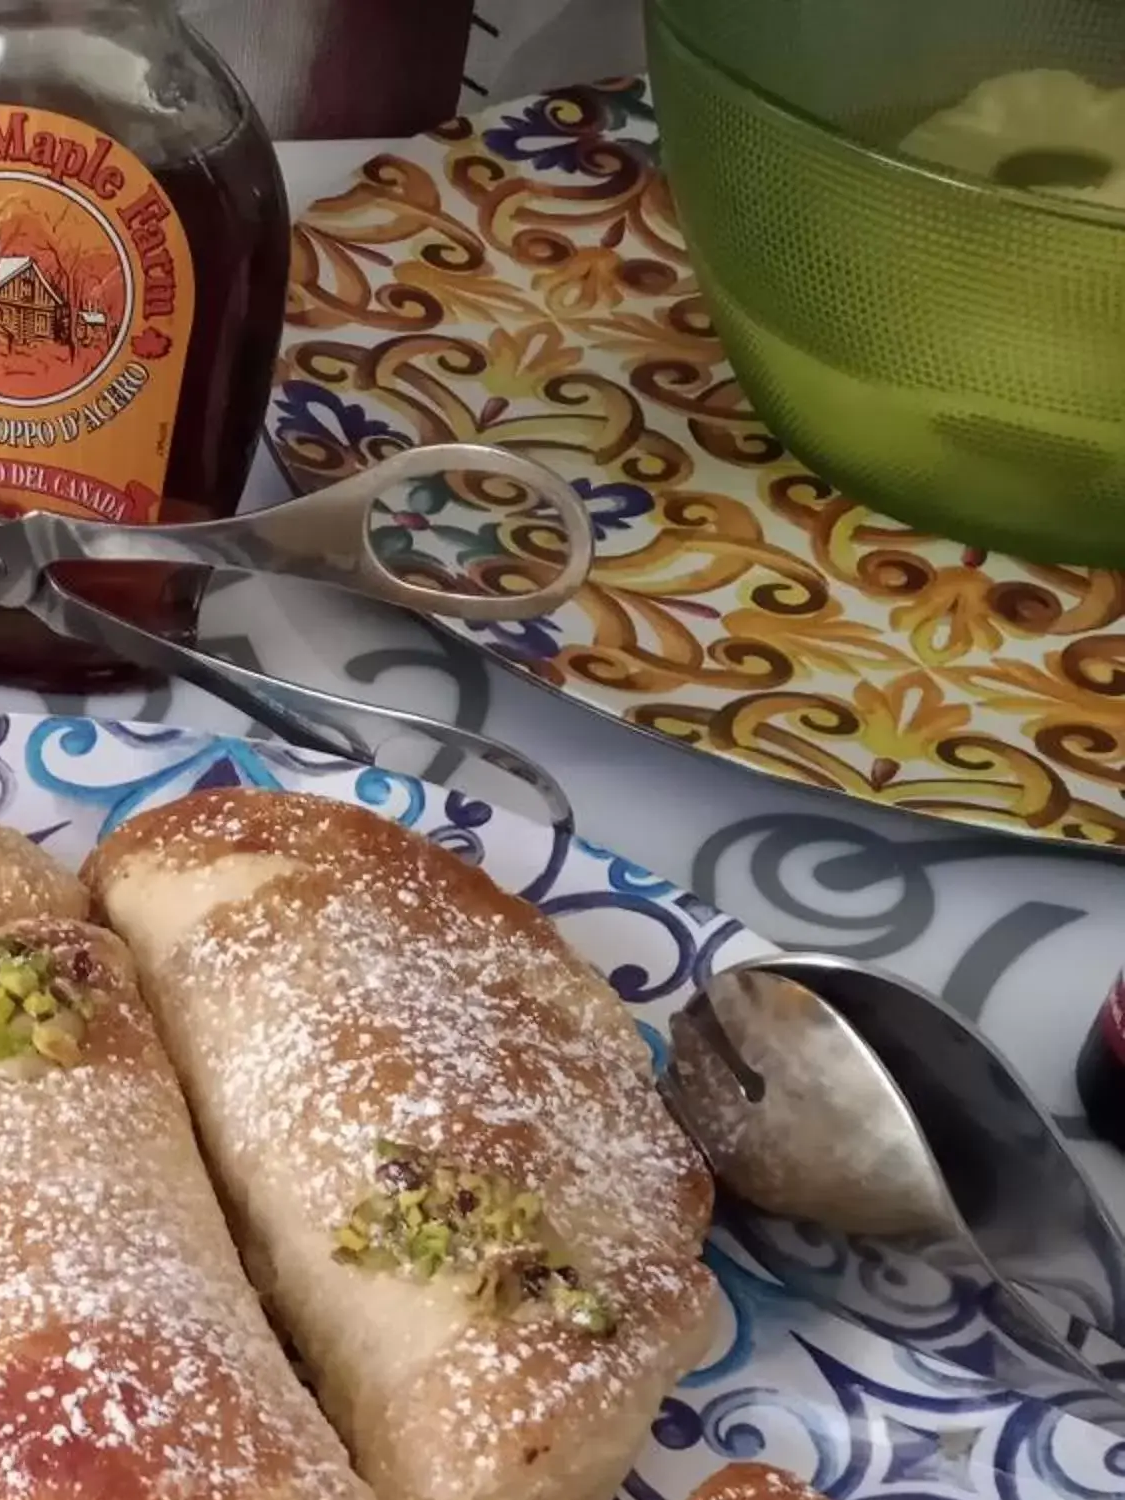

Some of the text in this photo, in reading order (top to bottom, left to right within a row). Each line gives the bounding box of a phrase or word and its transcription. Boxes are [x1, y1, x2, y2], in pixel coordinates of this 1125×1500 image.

[117, 183, 178, 321] Farm
[56, 361, 150, 443] D'ACERO
[11, 467, 48, 493] DEL
[54, 475, 126, 522] CANADA
